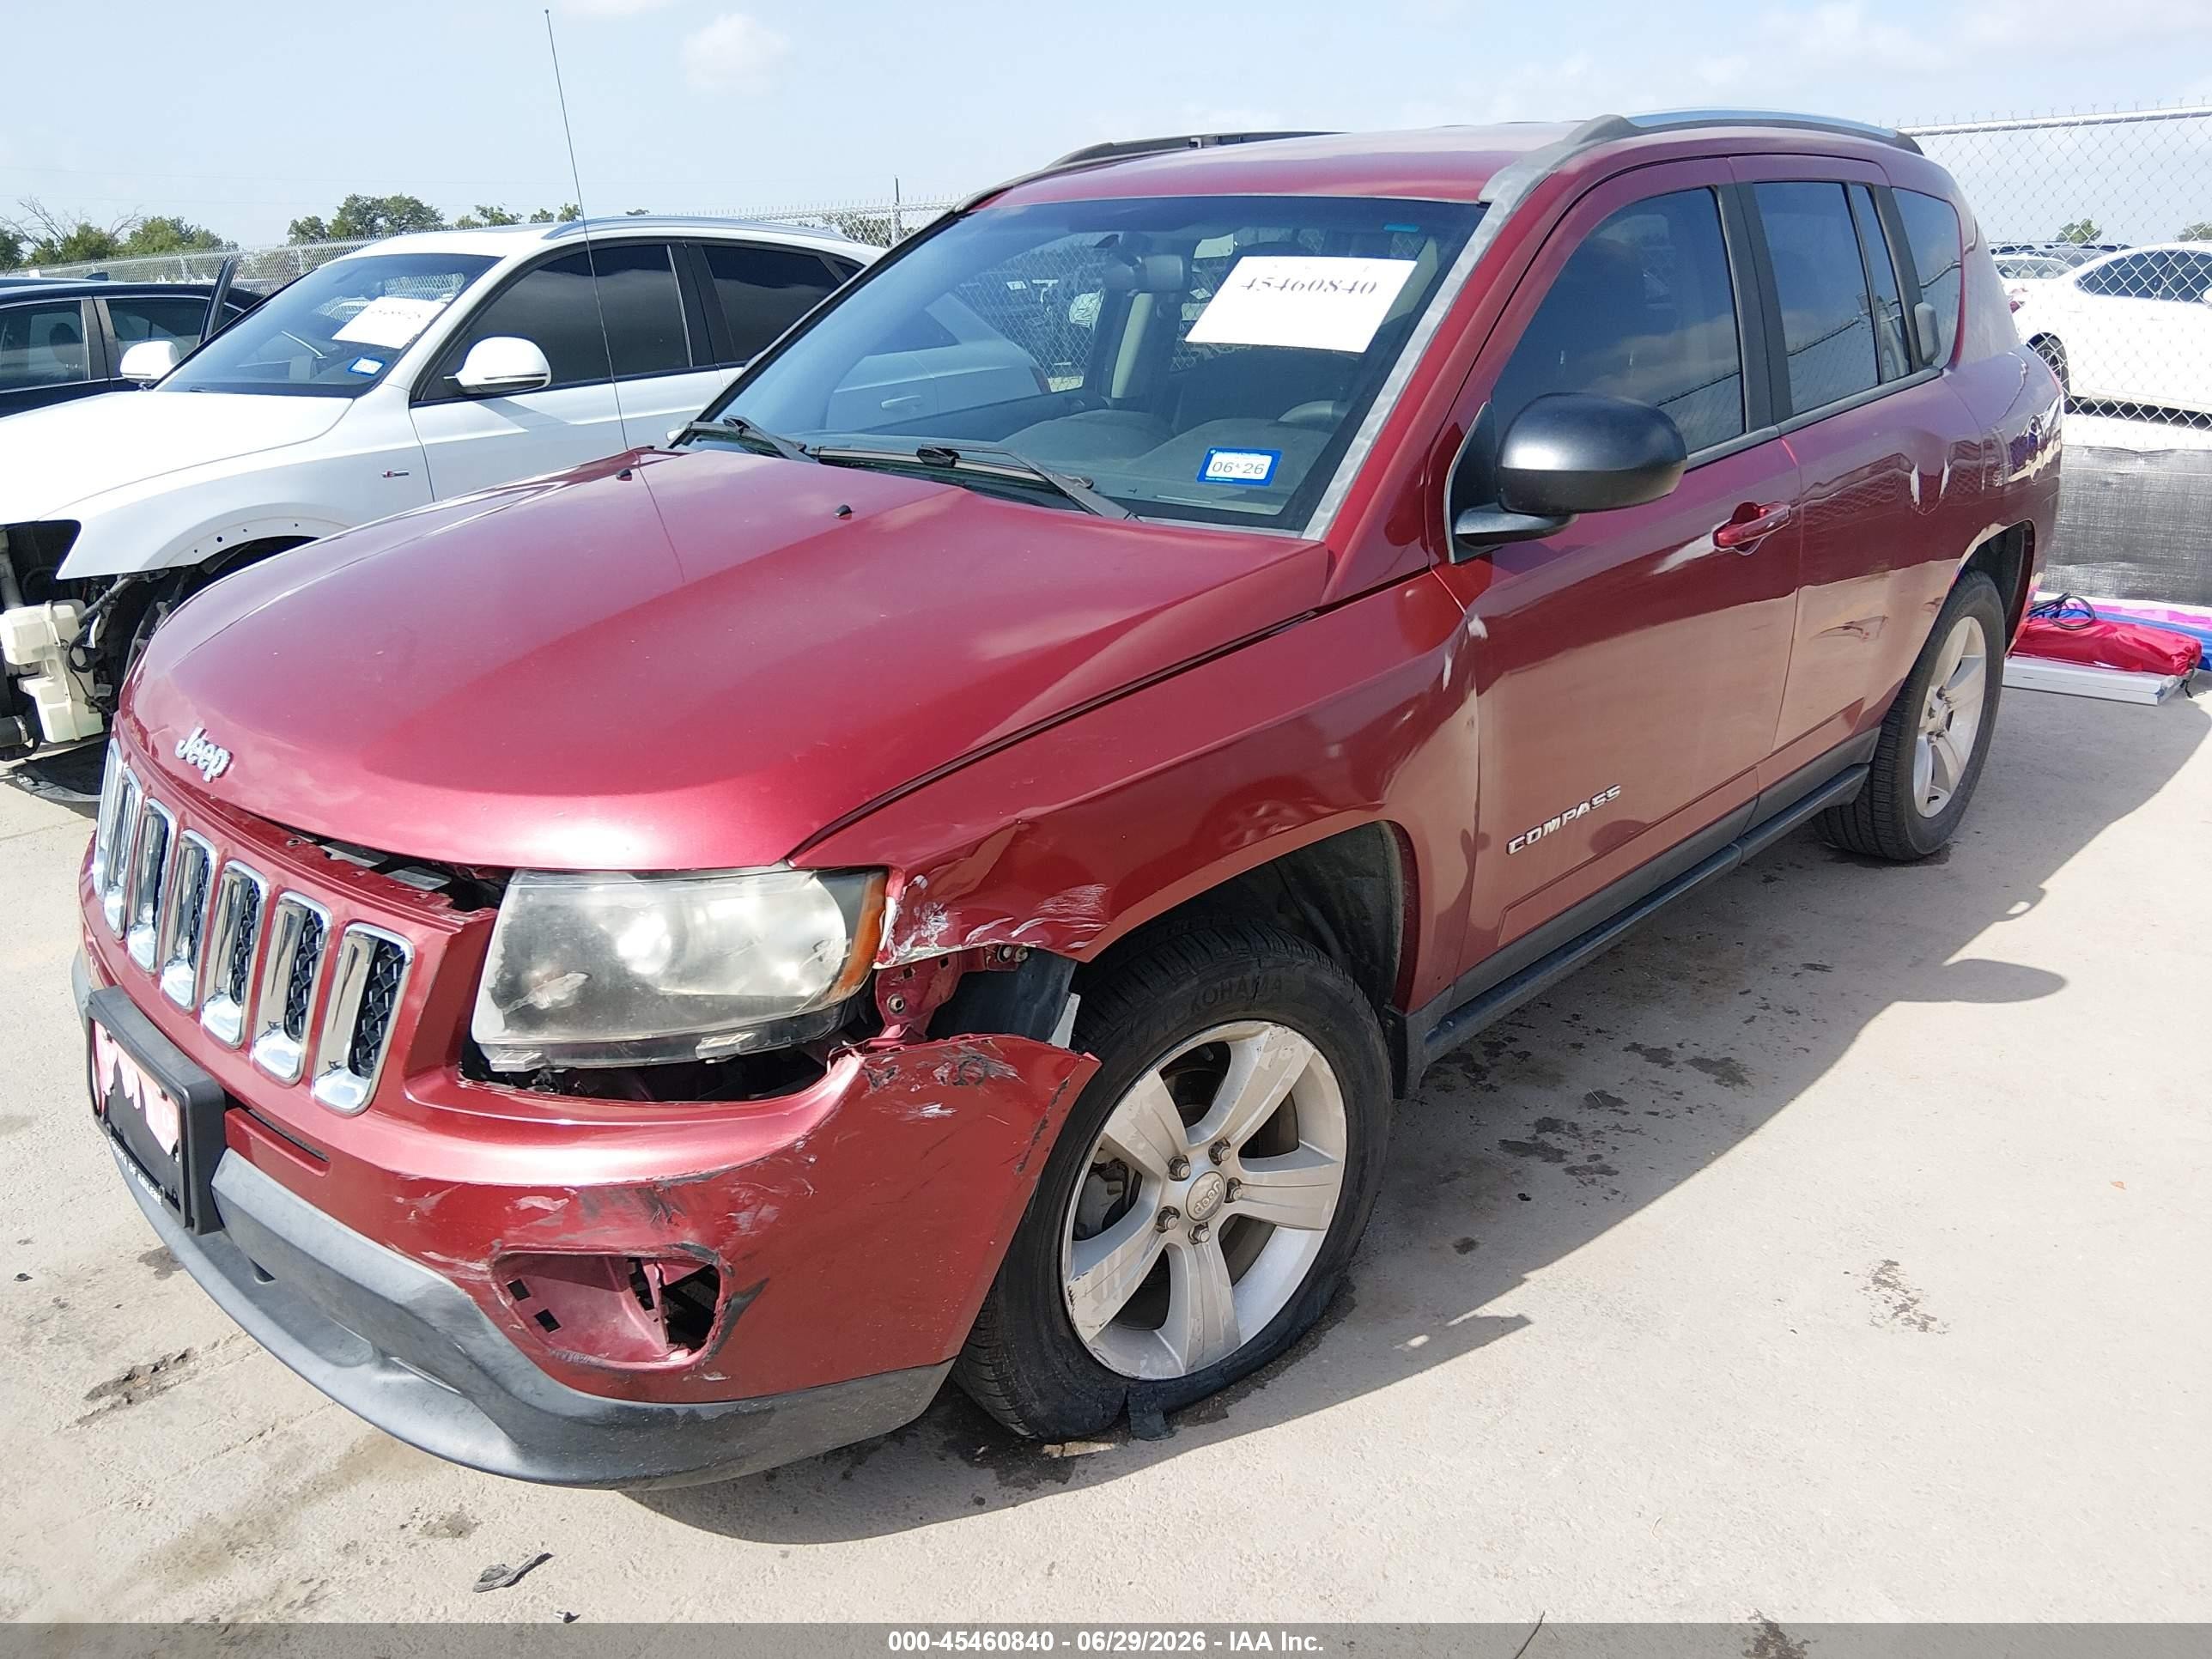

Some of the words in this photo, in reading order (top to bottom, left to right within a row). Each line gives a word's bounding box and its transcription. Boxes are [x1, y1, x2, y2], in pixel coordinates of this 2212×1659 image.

[1240, 276, 1378, 295] 45460840
[1212, 461, 1234, 473] 06
[1243, 462, 1265, 475] 26
[174, 726, 234, 783] Jeep
[1505, 783, 1621, 855] COMPASS
[1194, 1180, 1220, 1214] Jeep
